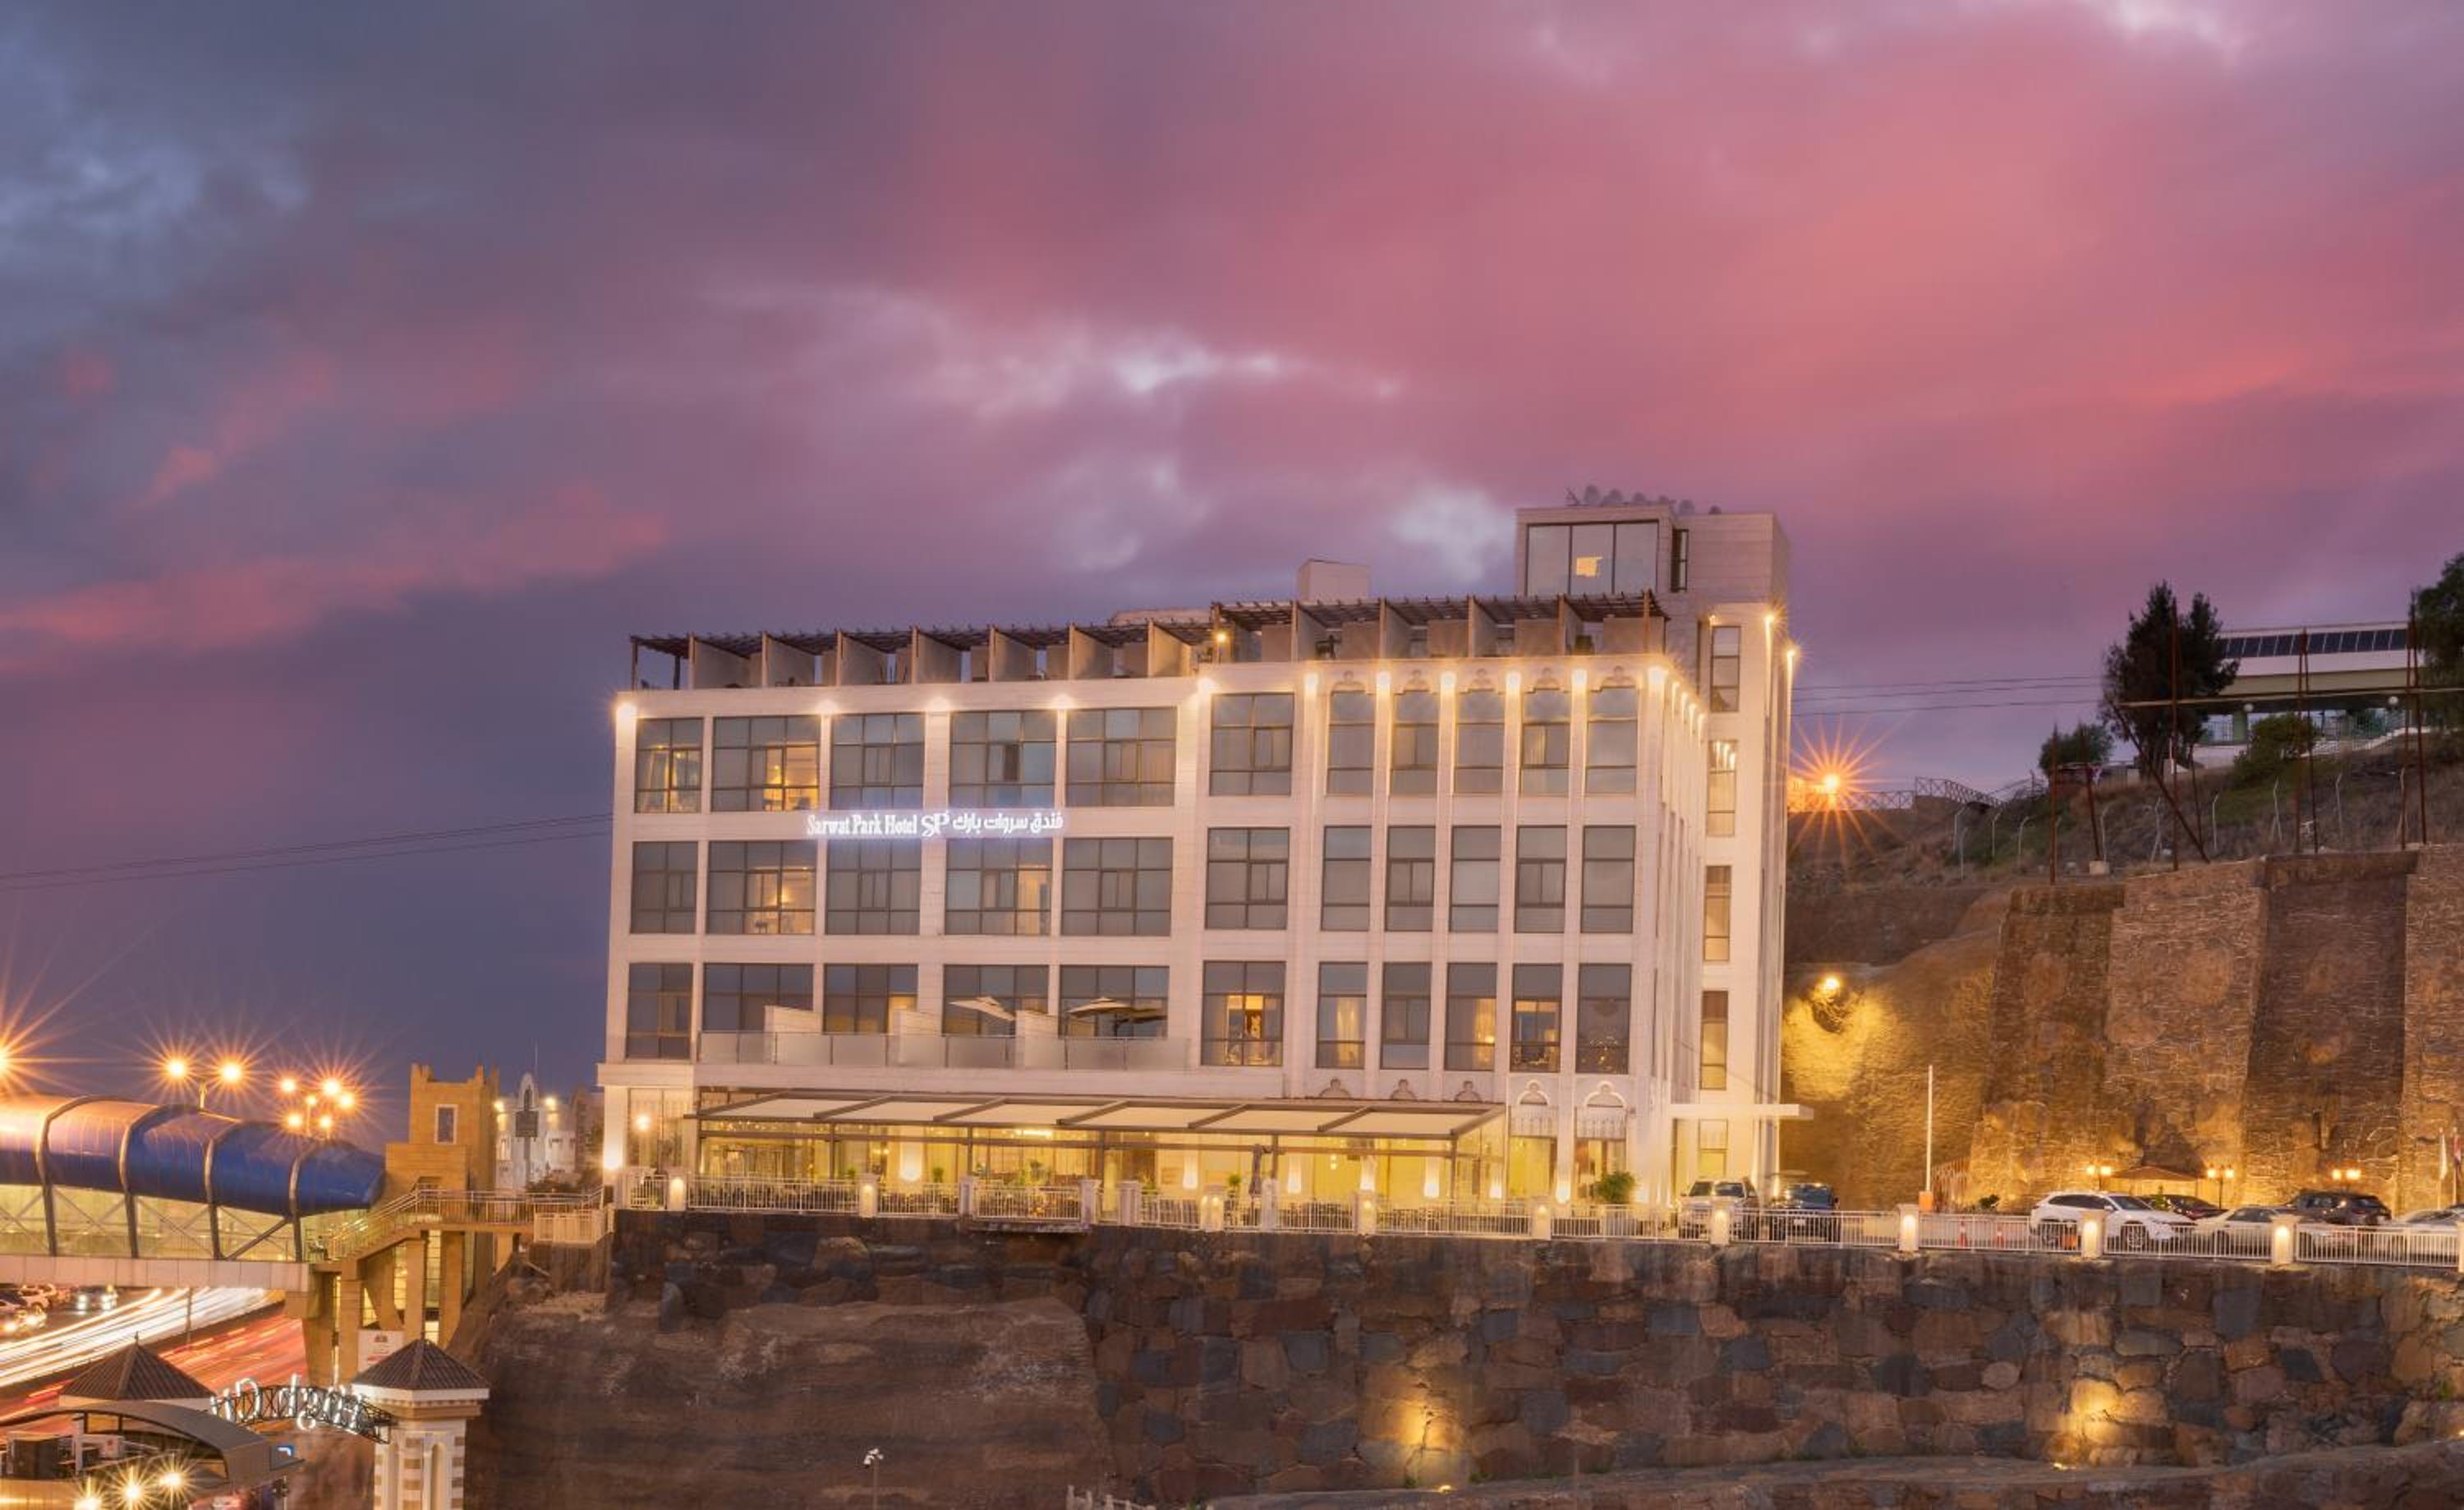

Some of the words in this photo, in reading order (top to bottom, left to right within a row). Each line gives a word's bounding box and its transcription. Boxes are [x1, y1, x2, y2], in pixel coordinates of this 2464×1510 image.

[807, 814, 849, 835] Sarwat
[852, 813, 881, 835] Park
[885, 814, 918, 835] Hotel
[921, 813, 950, 836] SP
[952, 812, 981, 835] بارك
[984, 812, 1028, 835] سروات
[1030, 811, 1064, 833] فندق
